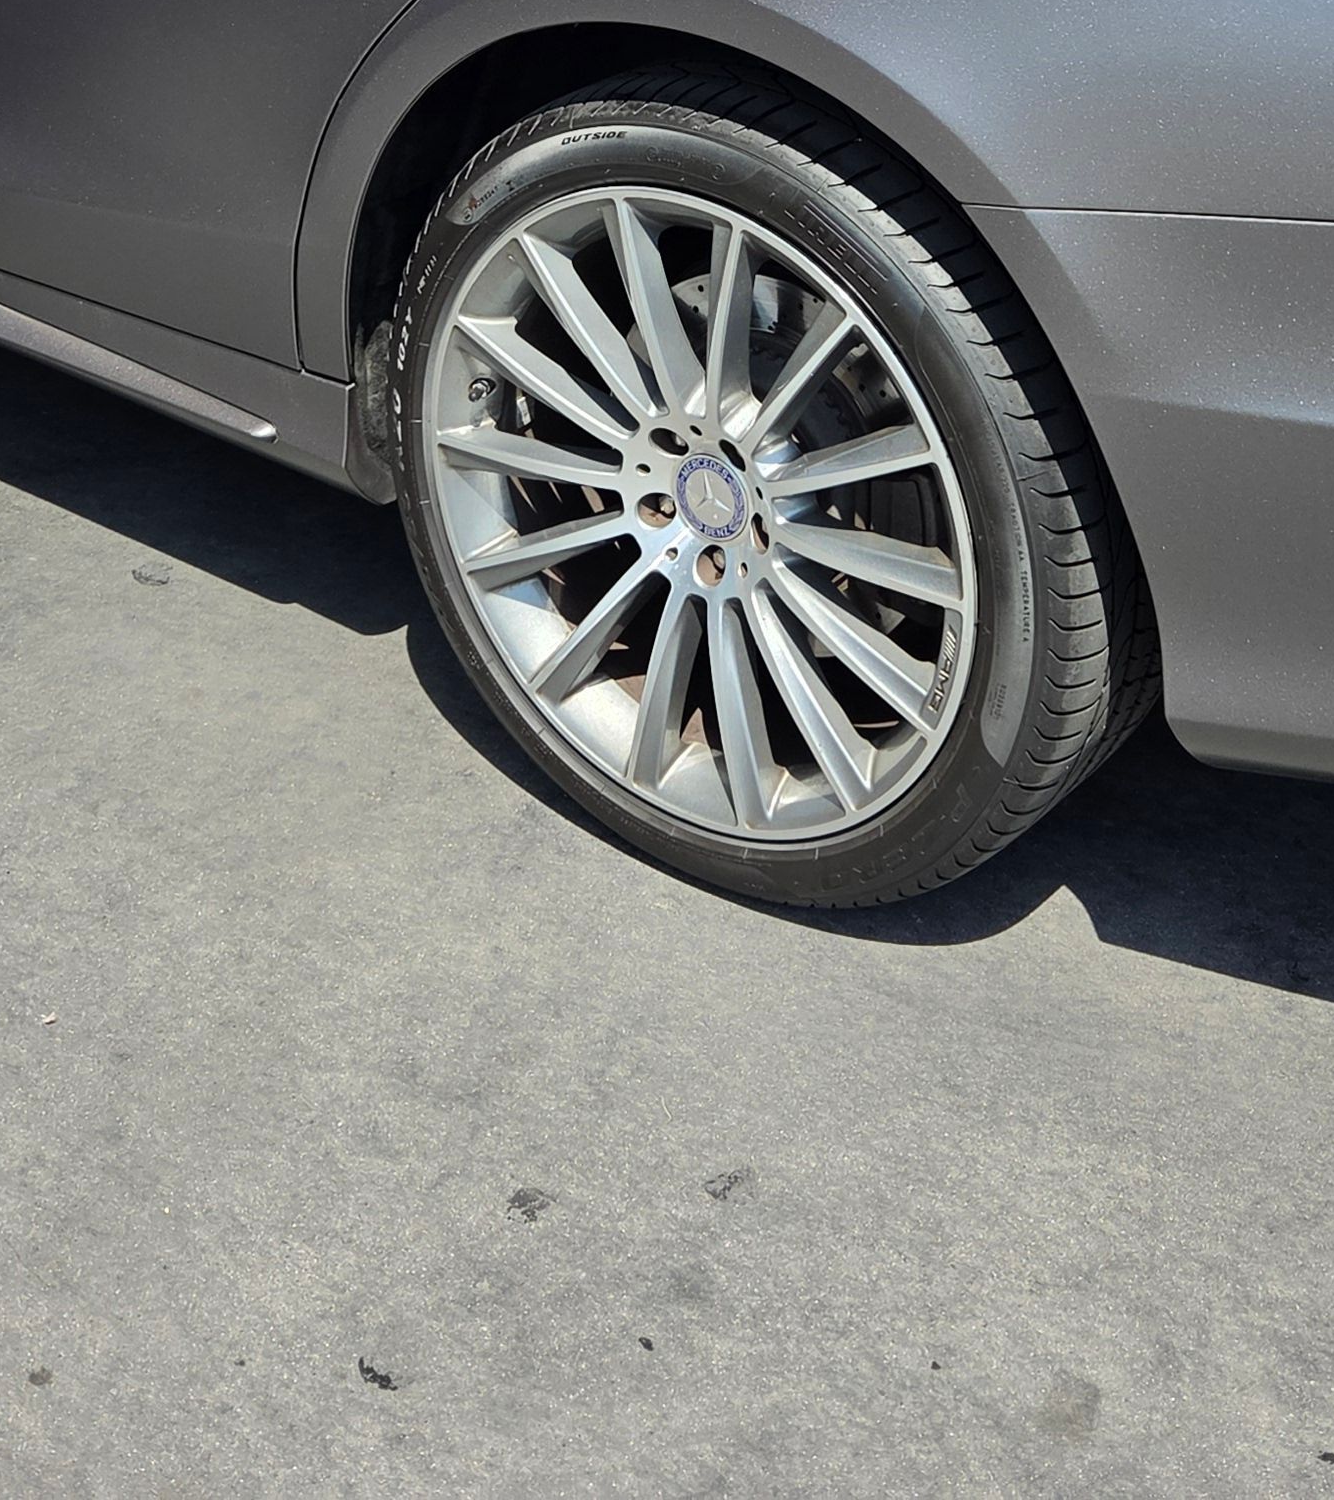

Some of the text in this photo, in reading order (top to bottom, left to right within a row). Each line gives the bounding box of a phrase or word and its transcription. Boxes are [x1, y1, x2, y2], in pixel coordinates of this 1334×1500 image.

[561, 130, 628, 146] OUTSIDE
[680, 457, 730, 480] MERCEDES
[704, 523, 732, 538] BENZ
[1020, 570, 1031, 633] TEMPERATURE
